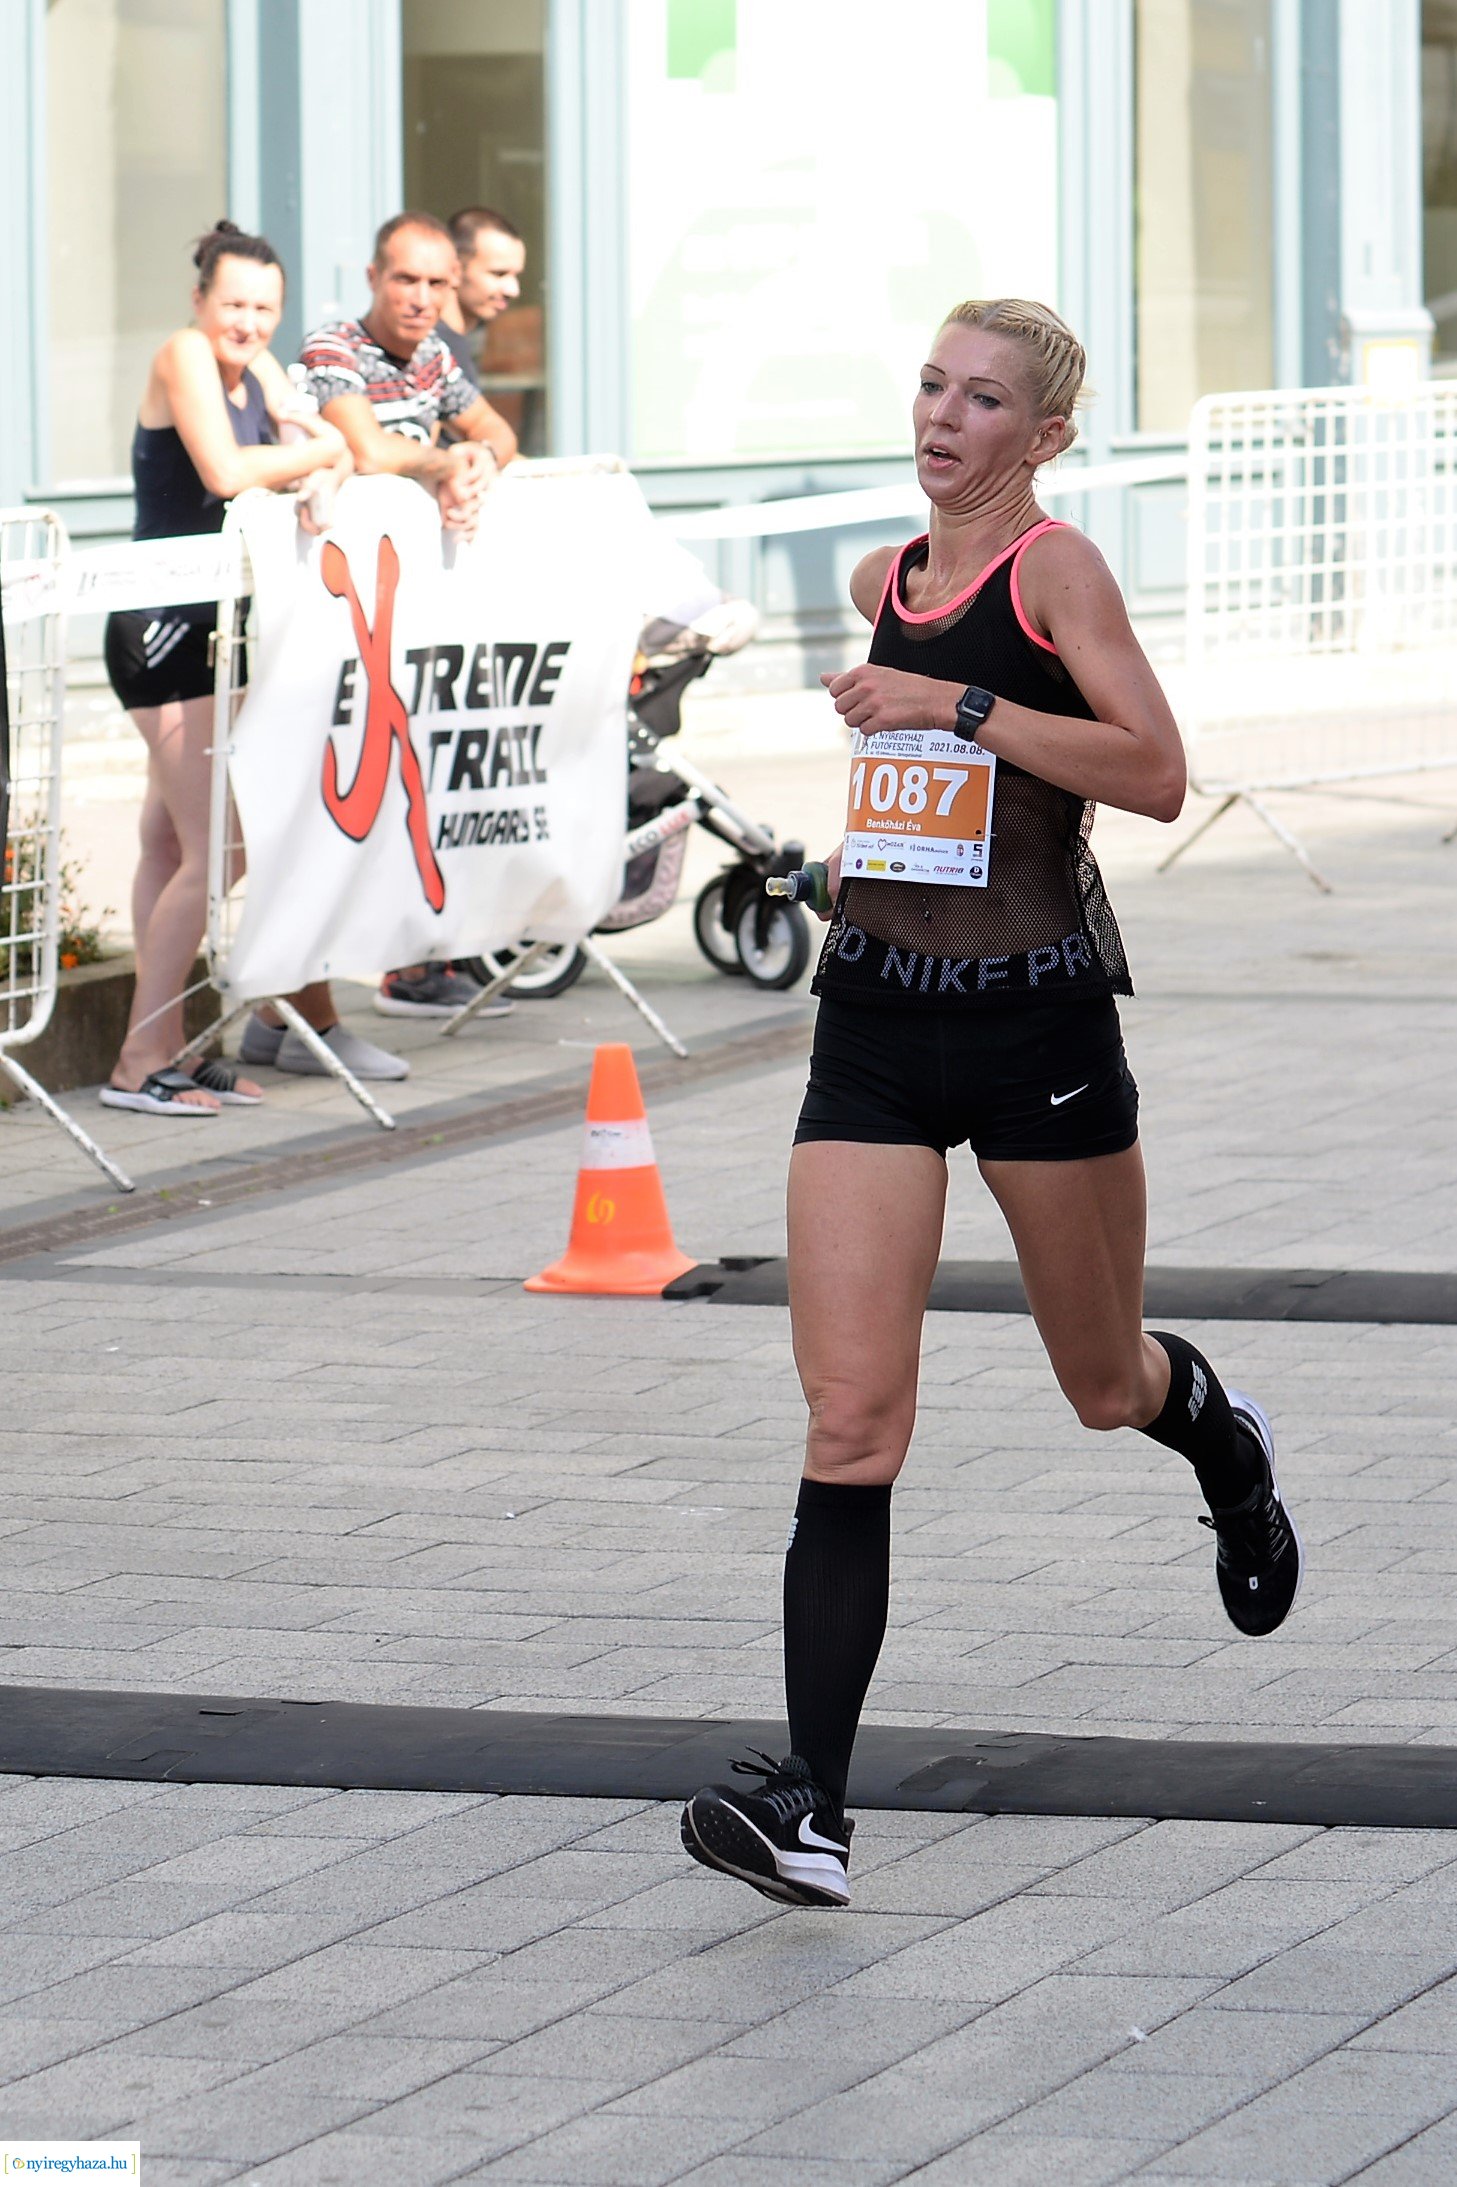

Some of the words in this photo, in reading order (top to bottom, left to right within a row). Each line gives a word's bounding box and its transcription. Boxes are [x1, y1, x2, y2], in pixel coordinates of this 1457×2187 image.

[428, 725, 547, 794] TRAIL
[929, 741, 985, 756] 2021.08.08.
[852, 762, 969, 817] 1087
[881, 946, 1010, 993] NIKE
